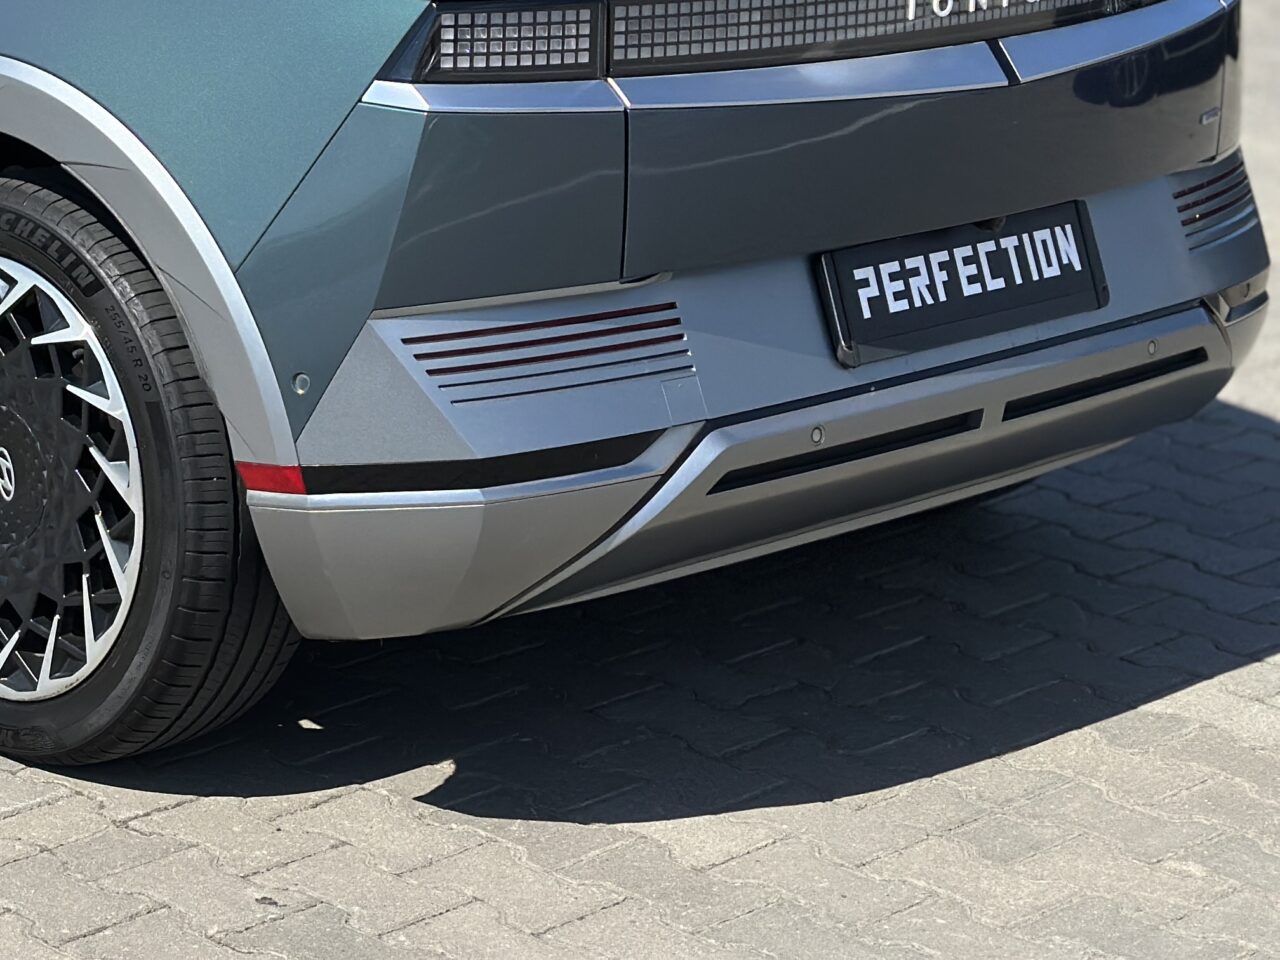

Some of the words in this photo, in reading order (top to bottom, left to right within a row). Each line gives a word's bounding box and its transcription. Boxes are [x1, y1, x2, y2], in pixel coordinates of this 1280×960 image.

[853, 224, 1082, 319] PERFECTION
[105, 305, 137, 353] 255/45
[132, 359, 144, 368] R
[138, 374, 152, 392] 20
